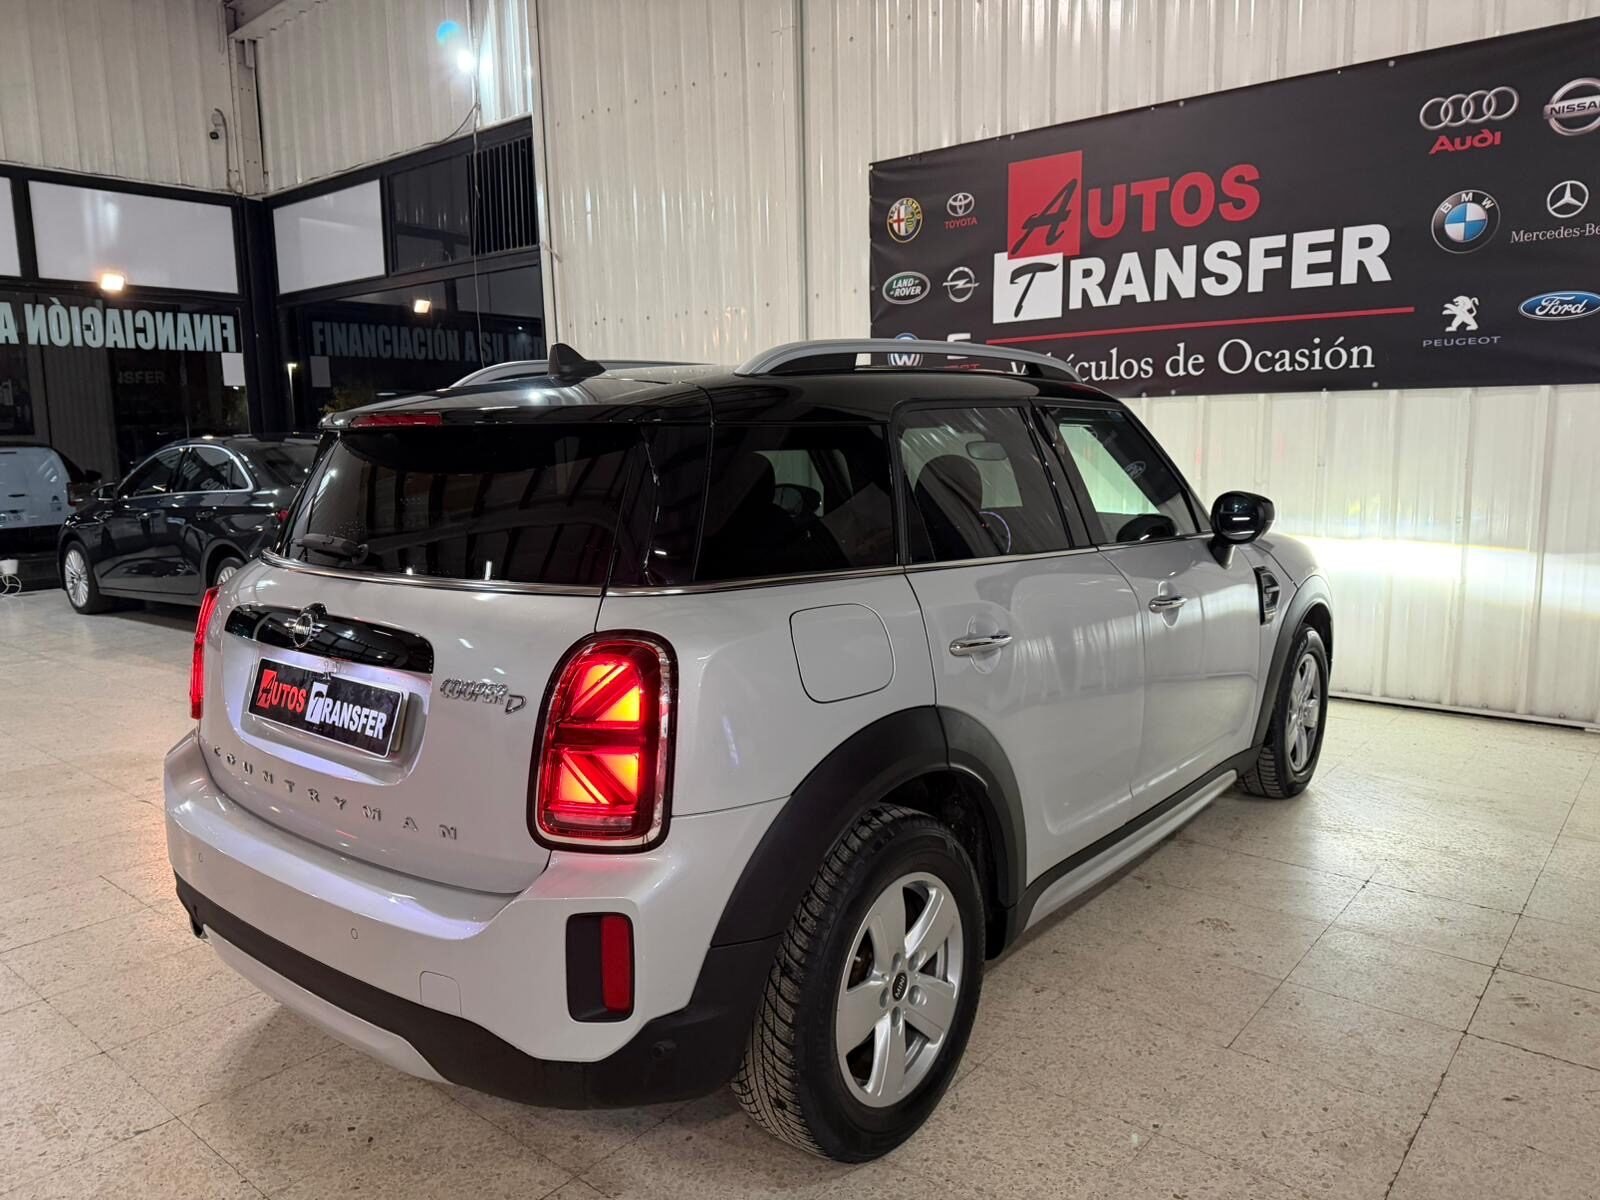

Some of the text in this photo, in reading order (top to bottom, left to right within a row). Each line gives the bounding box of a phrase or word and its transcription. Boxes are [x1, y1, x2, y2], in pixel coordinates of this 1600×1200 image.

[1549, 100, 1600, 115] NISSA
[1429, 129, 1502, 154] Audi
[1010, 164, 1262, 255] AUTOS
[1440, 192, 1495, 214] BMW
[944, 216, 978, 230] TOYOTA
[1008, 223, 1392, 318] TRANSFER
[892, 278, 914, 289] LAND
[894, 286, 922, 297] ROVER
[1535, 296, 1588, 315] Ford
[312, 320, 459, 361] FINANCIACIÓN
[463, 330, 479, 362] A
[1422, 335, 1501, 348] PEUGEOT
[1165, 342, 1205, 376] de
[1217, 336, 1375, 375] Ocasión
[257, 672, 388, 740] AUTOS TRANSFER
[440, 678, 527, 714] COOPER D
[213, 745, 458, 840] COUNTRYMAN
[894, 975, 906, 998] MINI
